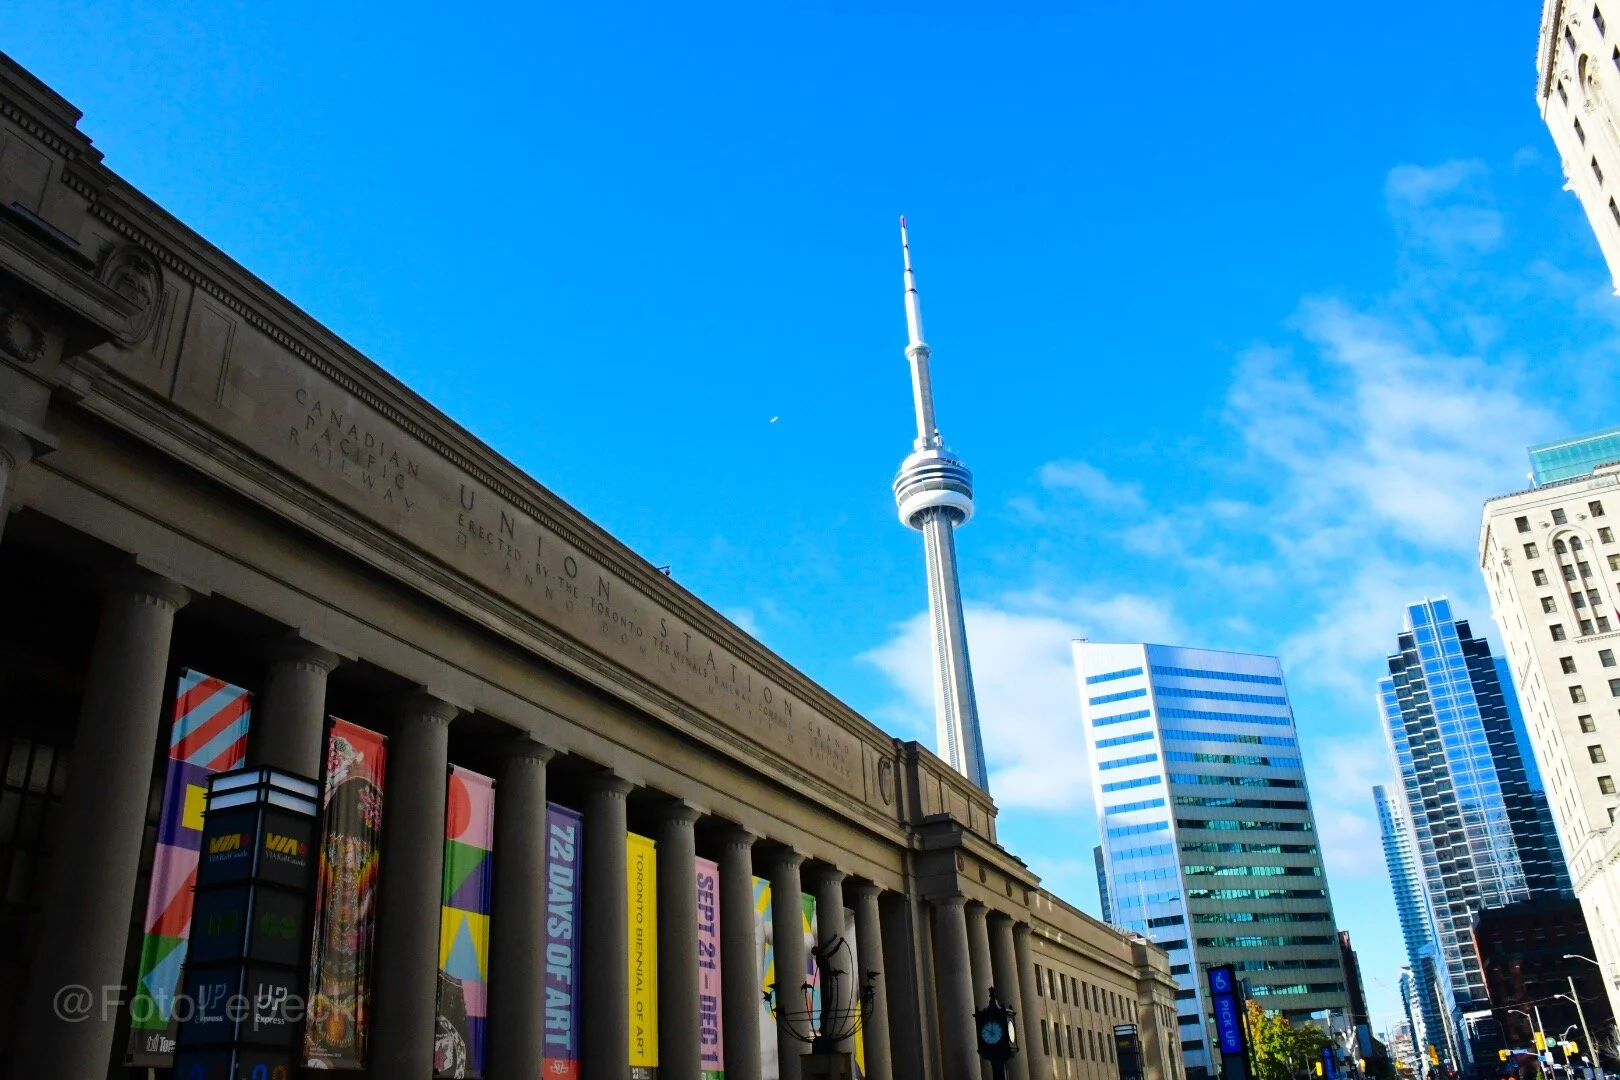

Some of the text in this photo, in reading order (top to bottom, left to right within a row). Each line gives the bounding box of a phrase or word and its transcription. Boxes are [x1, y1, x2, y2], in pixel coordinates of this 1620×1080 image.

[295, 388, 419, 478] CANADIAN
[305, 414, 405, 489] PACIFIC
[289, 425, 415, 513] RAILWAY
[458, 511, 522, 561] ERECTED
[535, 562, 549, 578] BY
[557, 576, 579, 599] THE
[589, 596, 644, 638] TORONTO
[460, 484, 793, 718] UNION STATION
[209, 833, 241, 854] VIA
[265, 832, 298, 856] VIA
[550, 824, 575, 860] 72
[547, 864, 574, 940] DAYS
[635, 852, 644, 923] TORONTO
[697, 872, 717, 937] SEPT
[546, 943, 572, 985] OF
[635, 928, 644, 996] BIENNIAL
[698, 942, 717, 973] 21
[197, 984, 227, 1009] UP
[256, 1013, 285, 1025] Express
[257, 983, 288, 1011] UP
[545, 986, 572, 1051] ART
[635, 1001, 643, 1022] OF
[636, 1025, 645, 1058] ART
[700, 996, 719, 1048] DEC
[1220, 1000, 1236, 1047] PICK UP
[700, 1051, 719, 1063] 1
